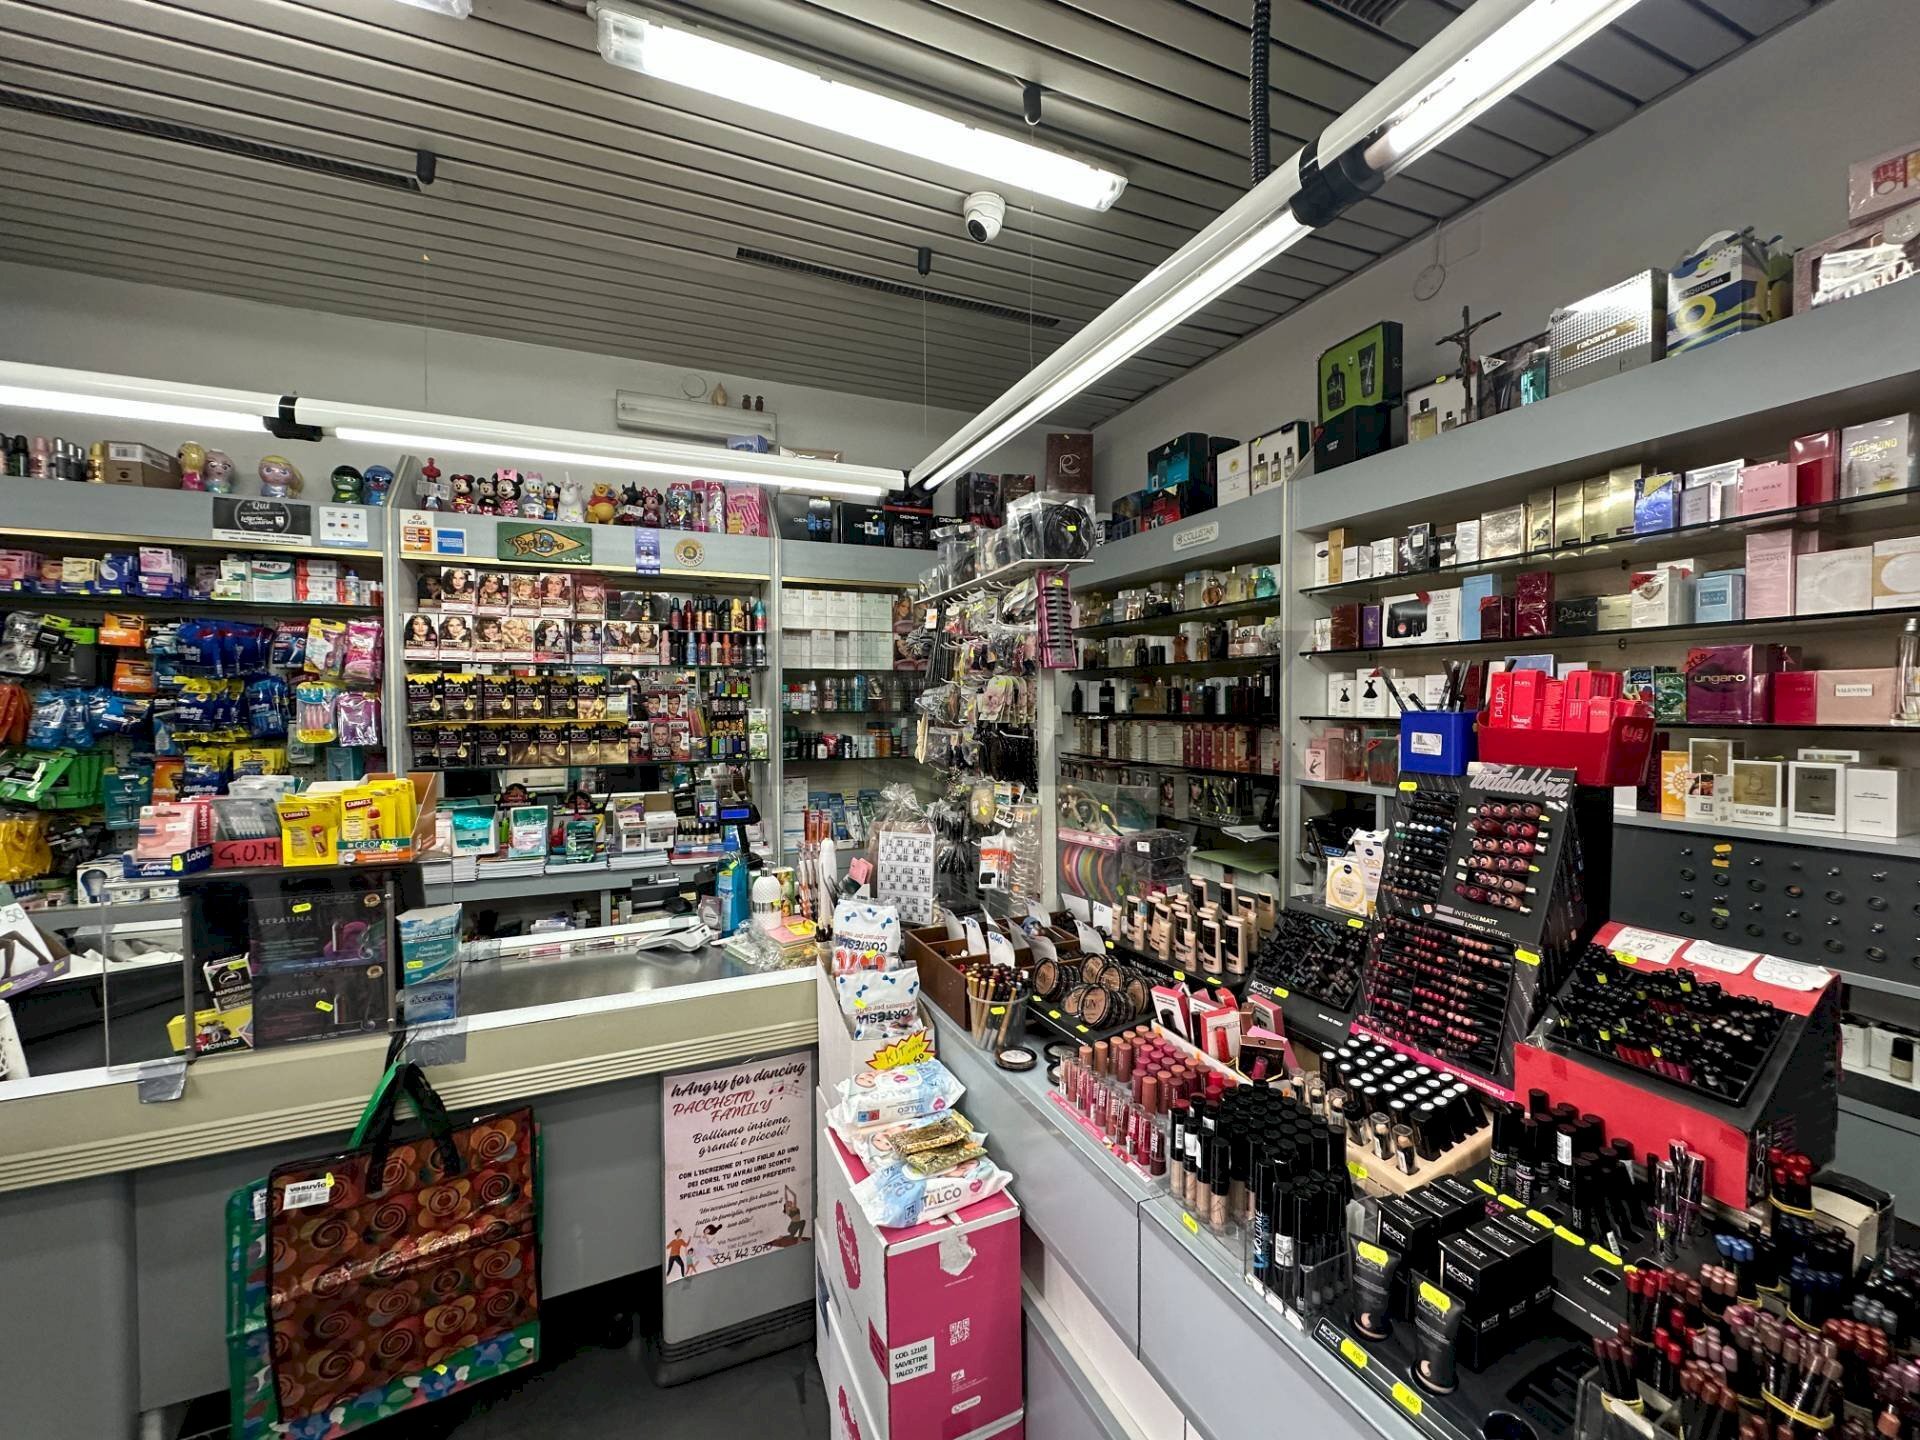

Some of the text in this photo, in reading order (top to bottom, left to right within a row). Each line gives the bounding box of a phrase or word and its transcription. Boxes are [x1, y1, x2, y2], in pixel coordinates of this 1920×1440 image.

[1577, 329, 1616, 350] rabanne
[1694, 673, 1746, 684] ungaro
[1495, 684, 1506, 718] PUPA
[346, 798, 372, 808] CARMEX
[1736, 808, 1774, 817] rabanne
[258, 914, 313, 926] KERATINA
[1454, 910, 1499, 926] INTENSEMATT
[1464, 921, 1511, 938] LONGLASTING
[260, 987, 328, 1000] ANTICADUTA
[1251, 979, 1276, 995] KOST
[201, 1037, 240, 1051] MODIANO
[885, 1046, 908, 1064] KIT
[671, 1062, 807, 1097] hAngry for dancing
[672, 1090, 756, 1116] PACCHETTO
[711, 1098, 773, 1123] FAMILY
[692, 1125, 744, 1144] Balliamo
[698, 1137, 740, 1158] grandi
[748, 1125, 791, 1146] piccoli!
[678, 1171, 692, 1180] CON
[693, 1163, 734, 1176] L'ISCRIZIONE
[743, 1157, 756, 1166] TUO
[756, 1153, 776, 1163] FIGLIO
[787, 1145, 800, 1155] UNO
[687, 1180, 699, 1188] DEI
[733, 1167, 753, 1178] AVRAI
[753, 1163, 767, 1173] UNO
[768, 1156, 792, 1169] SCONTO
[679, 1165, 798, 1200] SPECIALE SUL TUO CORSO PREFERITO.
[1446, 1178, 1473, 1195] KOST
[921, 1187, 962, 1206] TALCO
[1420, 1190, 1449, 1208] KOST
[1392, 1198, 1422, 1216] KOST
[1382, 1221, 1407, 1243] KOST
[1507, 1214, 1540, 1232] KOST
[1482, 1225, 1516, 1245] KOST
[1454, 1238, 1487, 1258] KOST
[1446, 1262, 1475, 1286] KOST
[1583, 1275, 1612, 1296] TESTER
[1509, 1300, 1527, 1315] KOST
[1481, 1314, 1500, 1328] KOST
[1321, 1324, 1342, 1342] KOST
[894, 1353, 929, 1370] SALVIETTINE
[896, 1367, 914, 1379] TALCO
